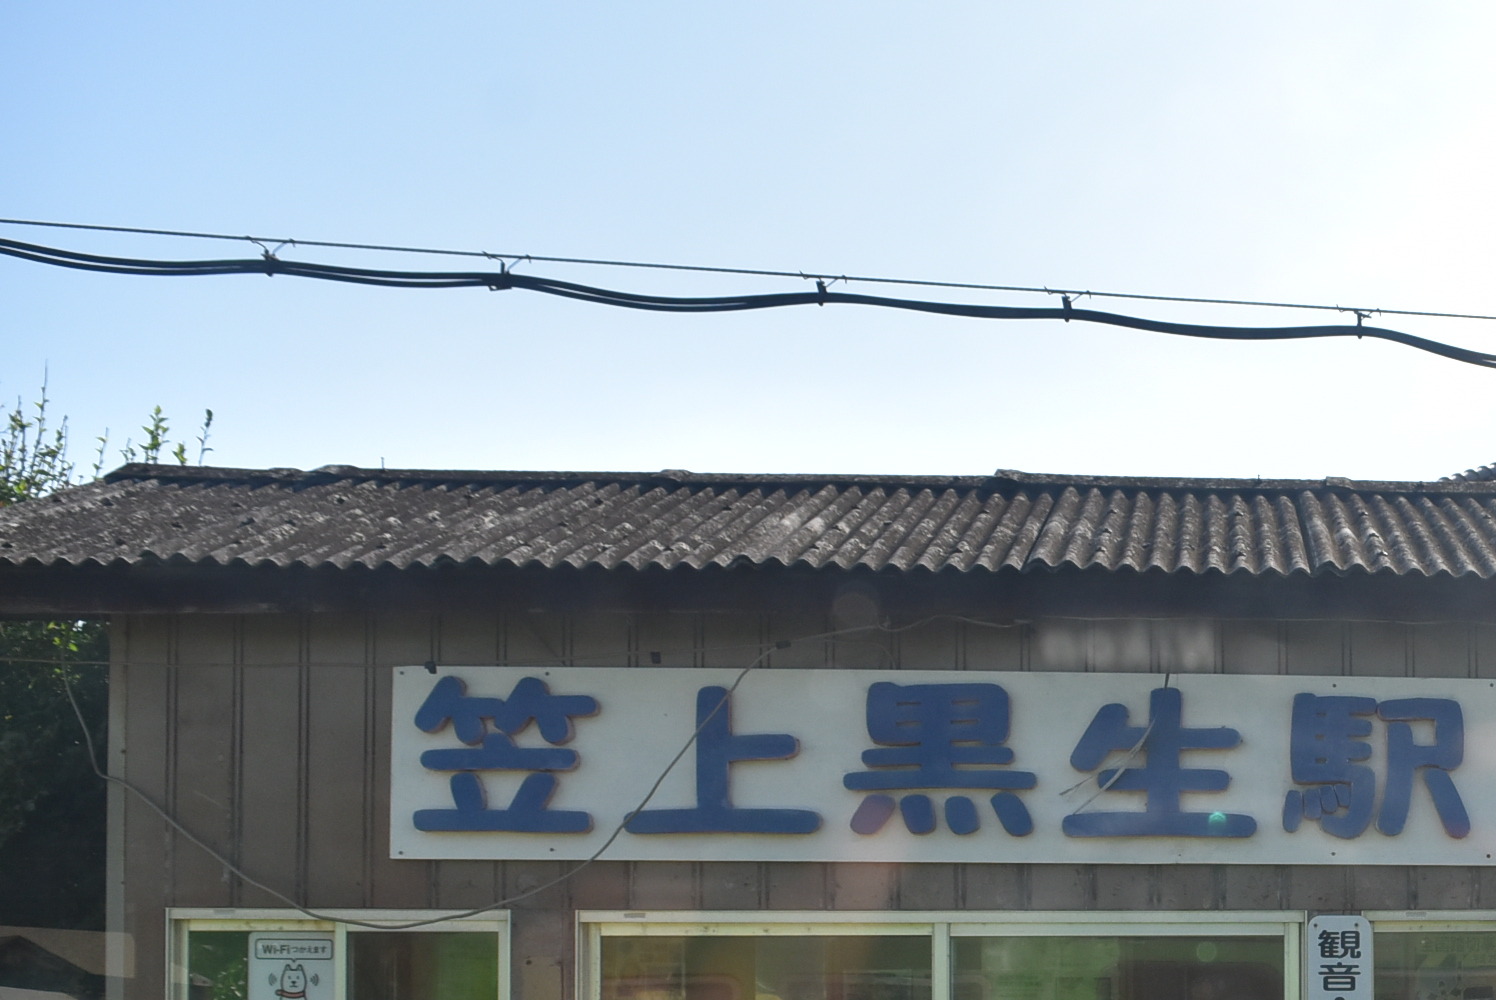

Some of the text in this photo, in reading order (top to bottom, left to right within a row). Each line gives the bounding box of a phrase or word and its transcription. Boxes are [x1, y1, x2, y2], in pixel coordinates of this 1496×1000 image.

[413, 675, 1470, 839] 笠上黒生駅
